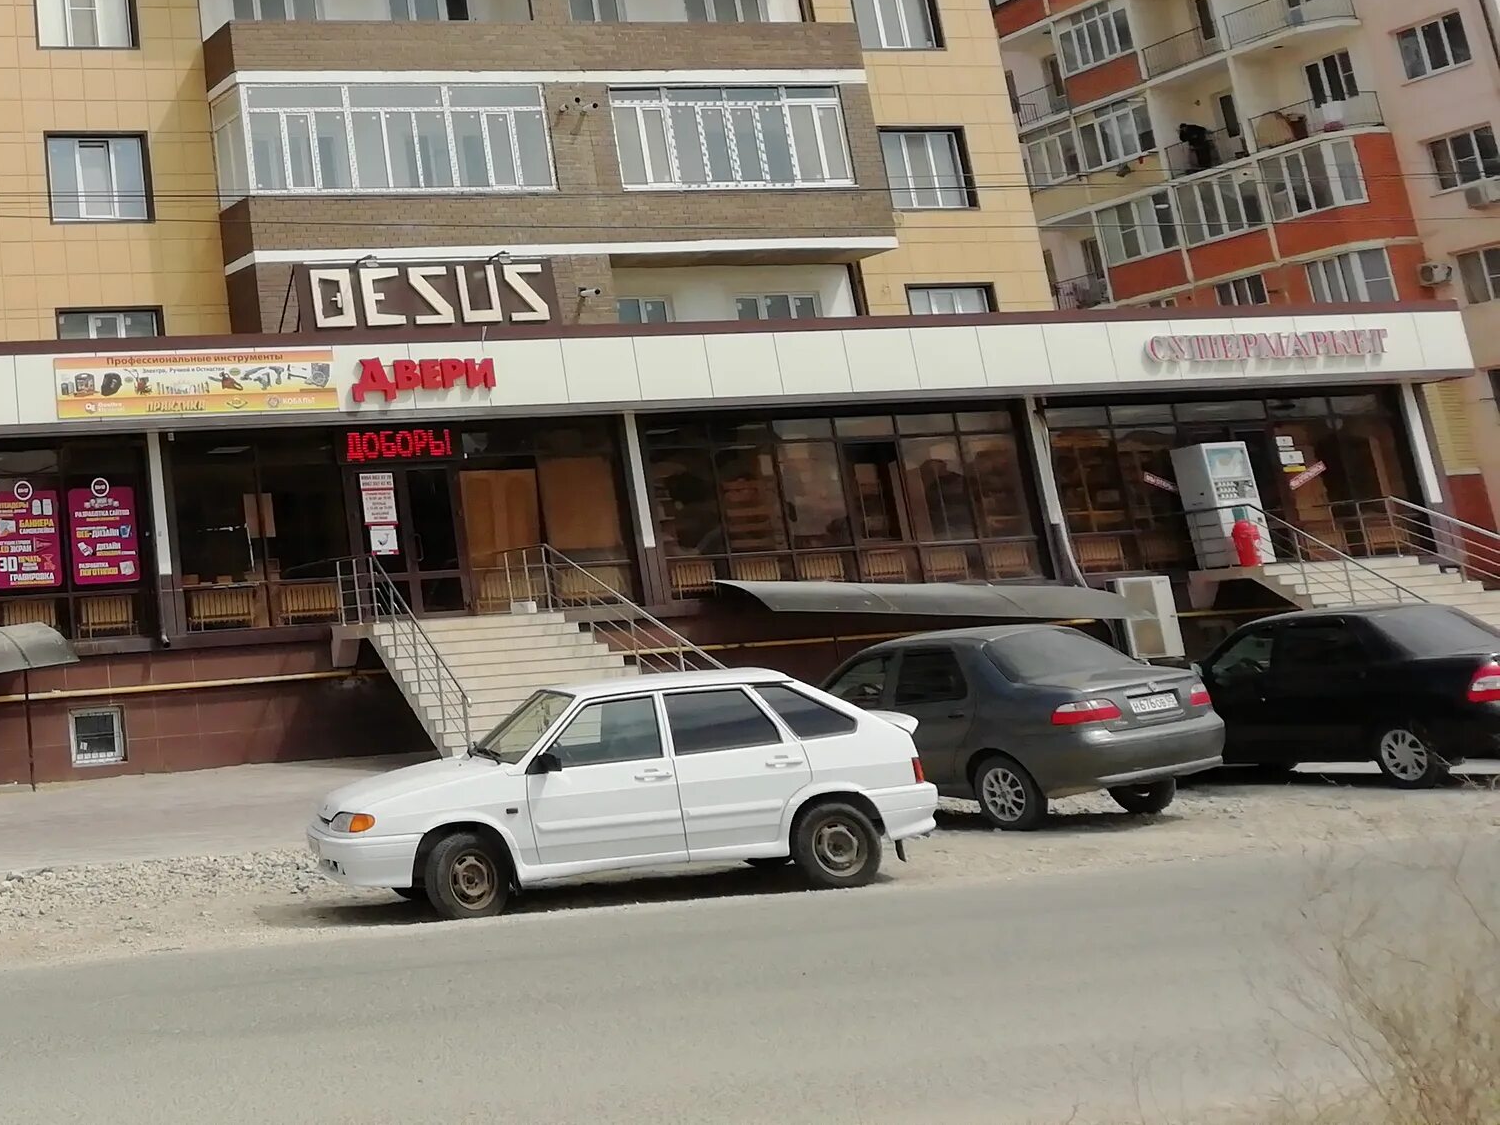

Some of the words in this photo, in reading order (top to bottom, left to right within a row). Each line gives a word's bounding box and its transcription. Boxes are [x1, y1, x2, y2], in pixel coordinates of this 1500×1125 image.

[1145, 328, 1389, 362] СУПЕРМАРКЕТ
[106, 355, 211, 366] Профессиональные
[214, 354, 284, 364] инструменты
[351, 356, 496, 403] ДВЕРИ
[145, 400, 206, 412] ПРАКТИКА
[346, 428, 452, 461] ДОБОРЫ
[75, 510, 108, 518] РАЗРАБОТКА
[19, 518, 54, 528] БАННЕРА
[96, 541, 121, 551] ДИЗАЙН
[0, 556, 18, 572] 3D
[10, 572, 55, 581] ГРАВИРОВКА
